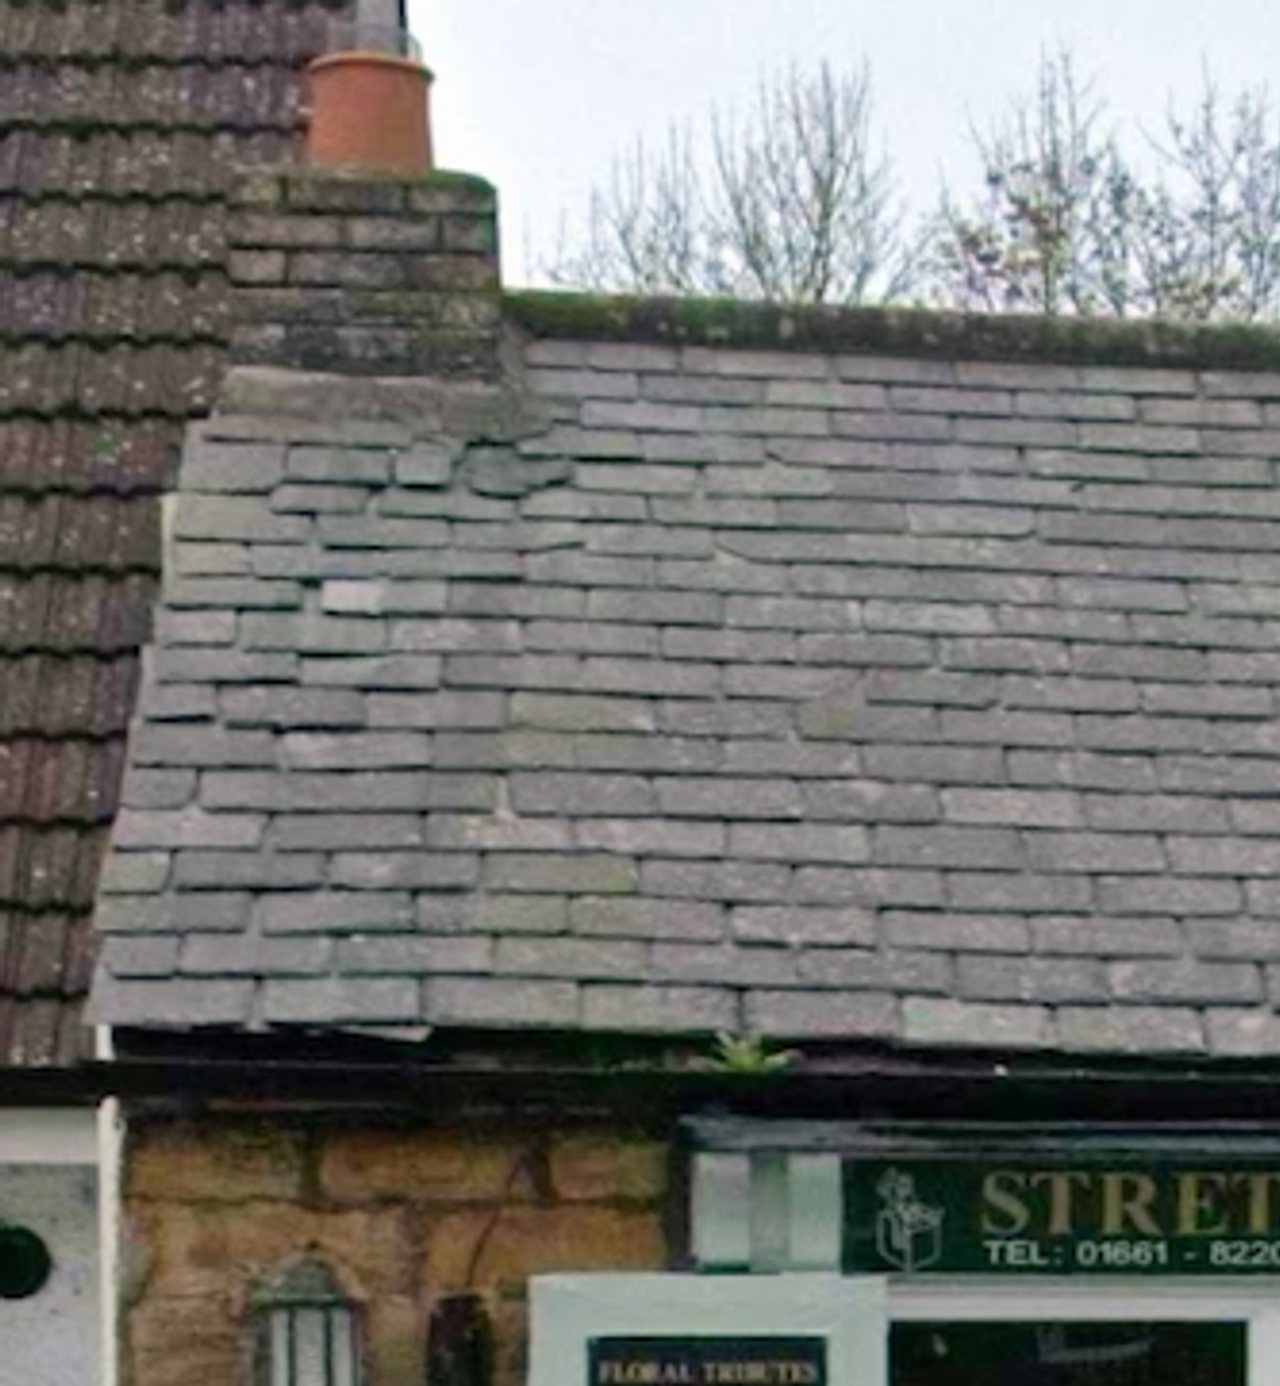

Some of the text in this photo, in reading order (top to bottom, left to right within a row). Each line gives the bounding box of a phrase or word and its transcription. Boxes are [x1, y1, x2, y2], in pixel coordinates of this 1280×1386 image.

[983, 1240, 1063, 1266] TEL:
[1076, 1240, 1169, 1266] 01661
[598, 1360, 818, 1384] FLORAL TRIBUTES
